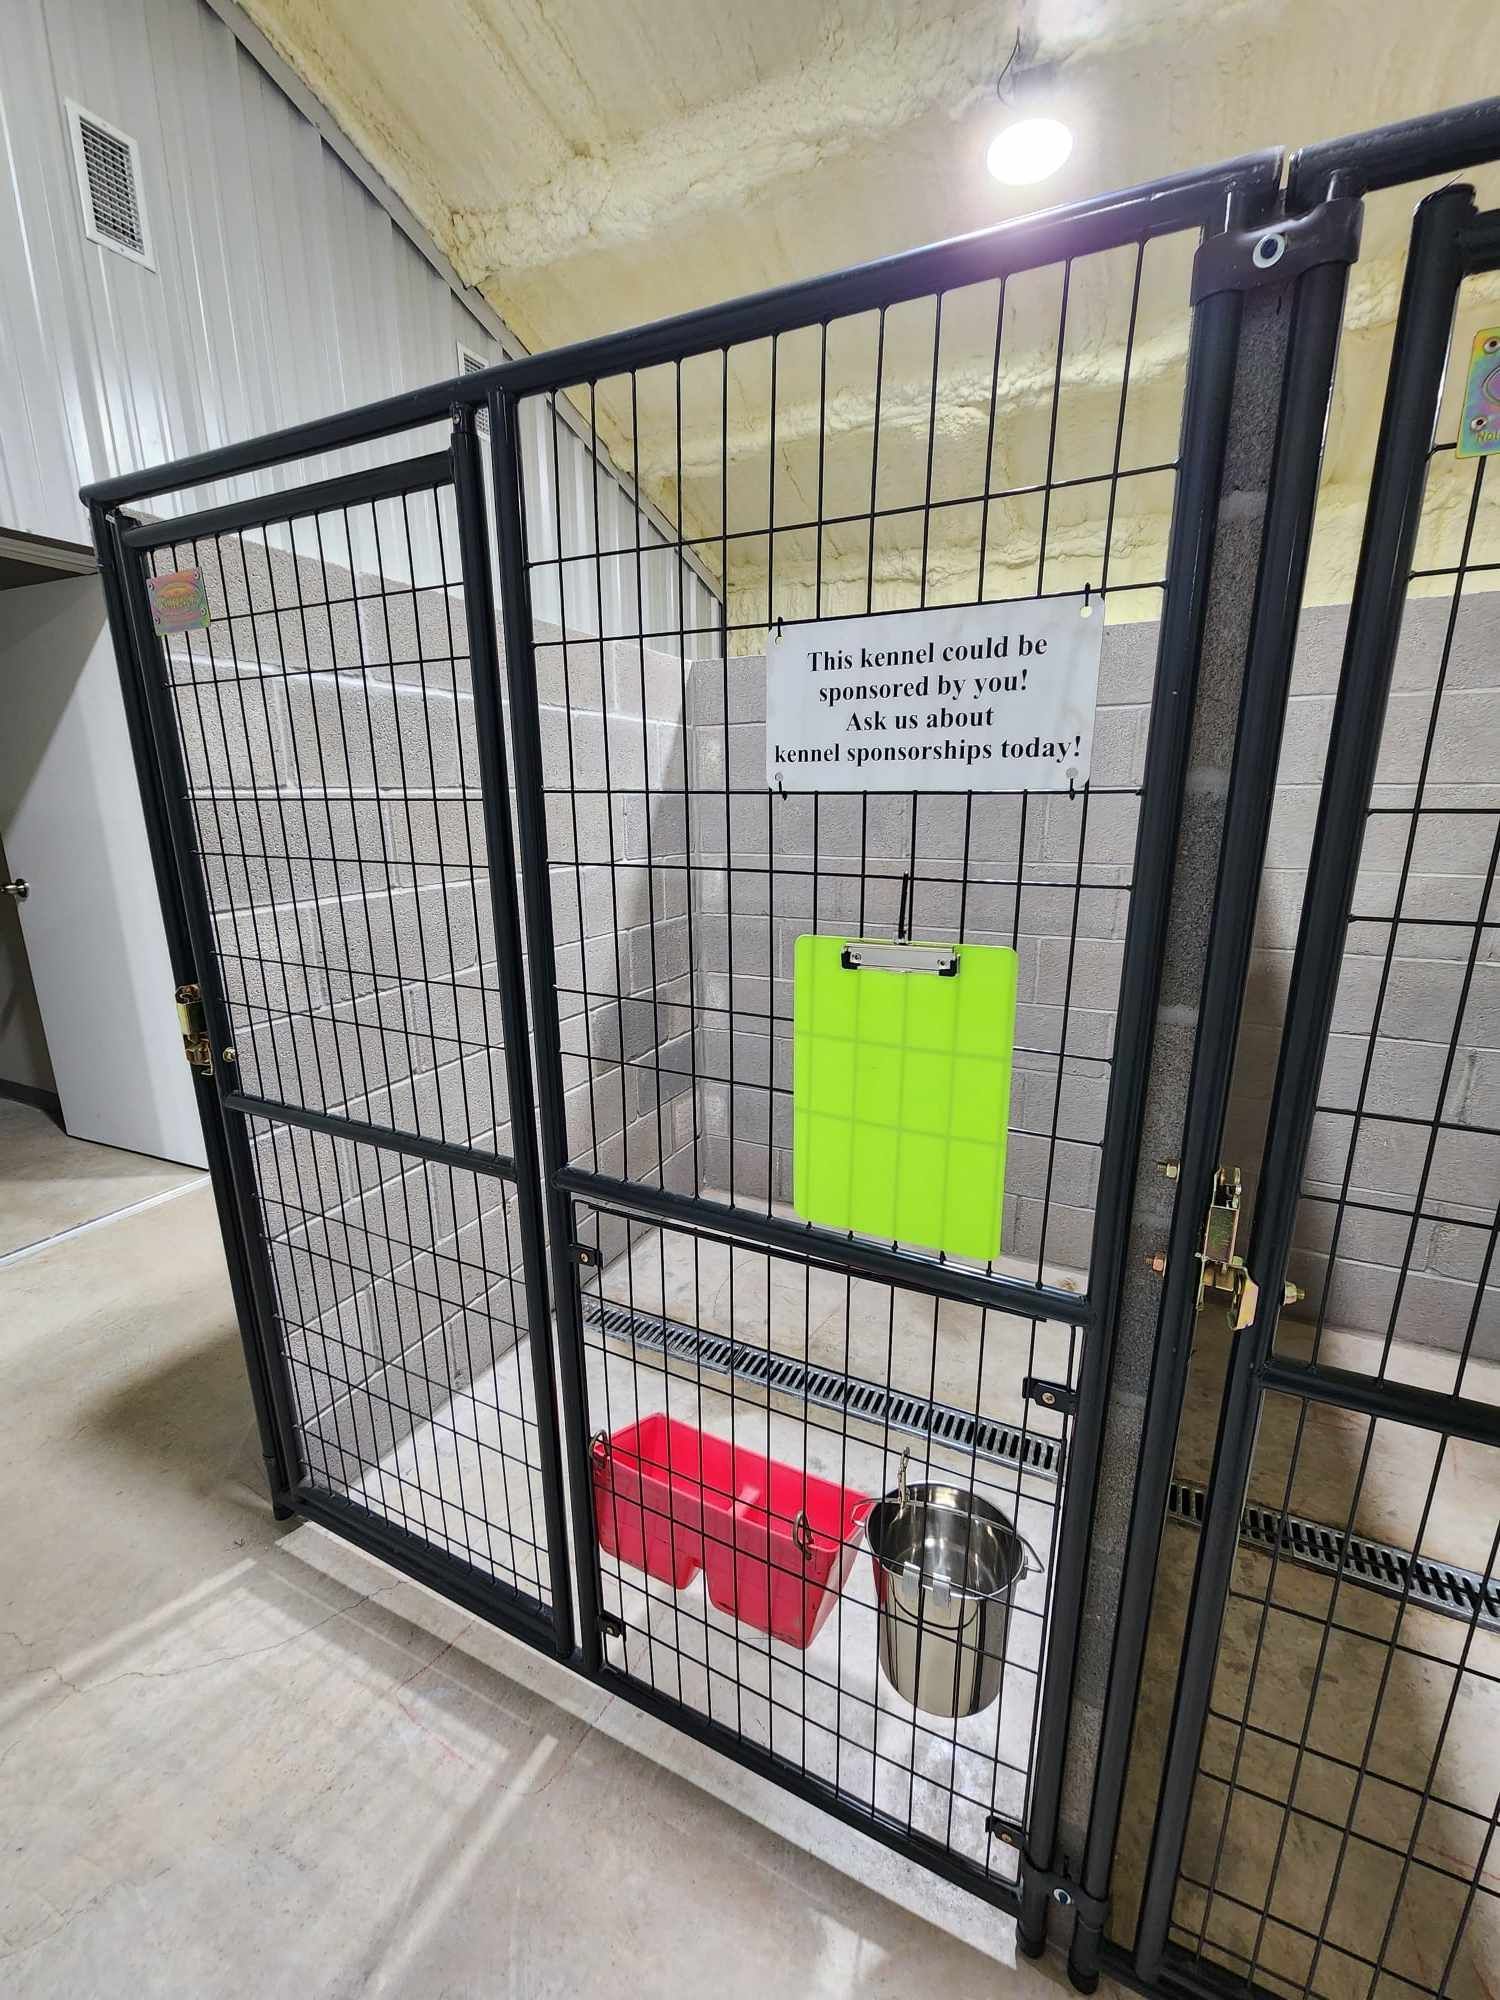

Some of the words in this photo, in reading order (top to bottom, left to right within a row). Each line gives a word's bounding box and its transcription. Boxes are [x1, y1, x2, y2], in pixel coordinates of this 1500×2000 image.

[807, 649, 853, 672] This
[860, 641, 934, 669] kennel
[942, 635, 1009, 662] could
[1018, 634, 1048, 657] be
[819, 675, 929, 708] sponsored
[937, 674, 966, 701] by
[973, 668, 1028, 700] you!
[845, 710, 887, 732] Ask
[895, 714, 919, 730] us
[926, 707, 995, 729] about
[775, 743, 840, 763] kennel
[847, 739, 992, 768] sponsorships
[1001, 735, 1081, 764] today!
